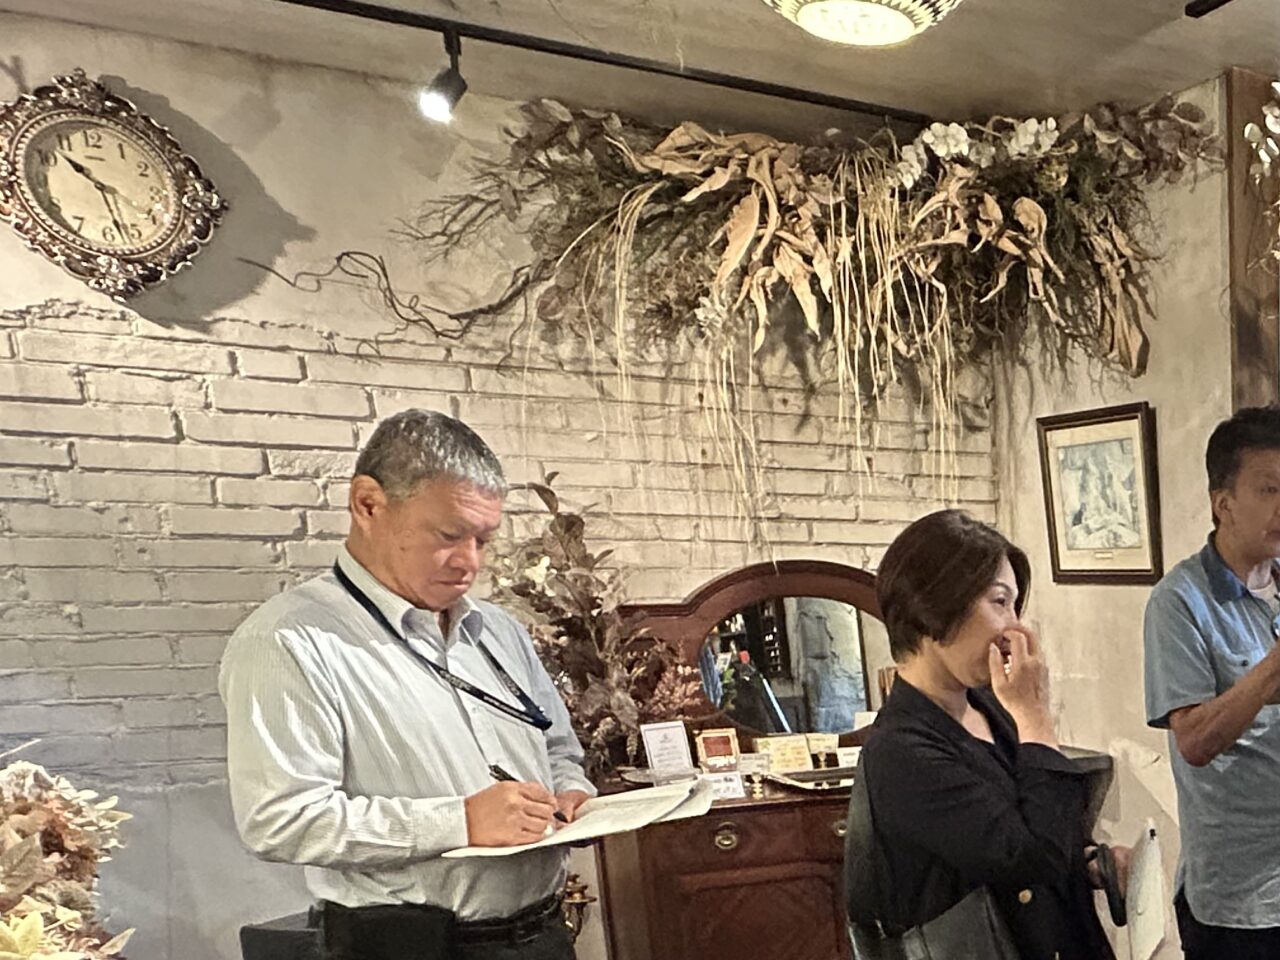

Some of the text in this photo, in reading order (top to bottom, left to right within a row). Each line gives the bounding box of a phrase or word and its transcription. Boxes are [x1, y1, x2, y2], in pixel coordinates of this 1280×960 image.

[56, 133, 72, 152] 11
[83, 129, 102, 149] 12
[118, 142, 126, 160] 1
[137, 161, 149, 178] 2
[72, 214, 85, 234] 7
[130, 223, 142, 240] 5
[102, 226, 116, 243] 6
